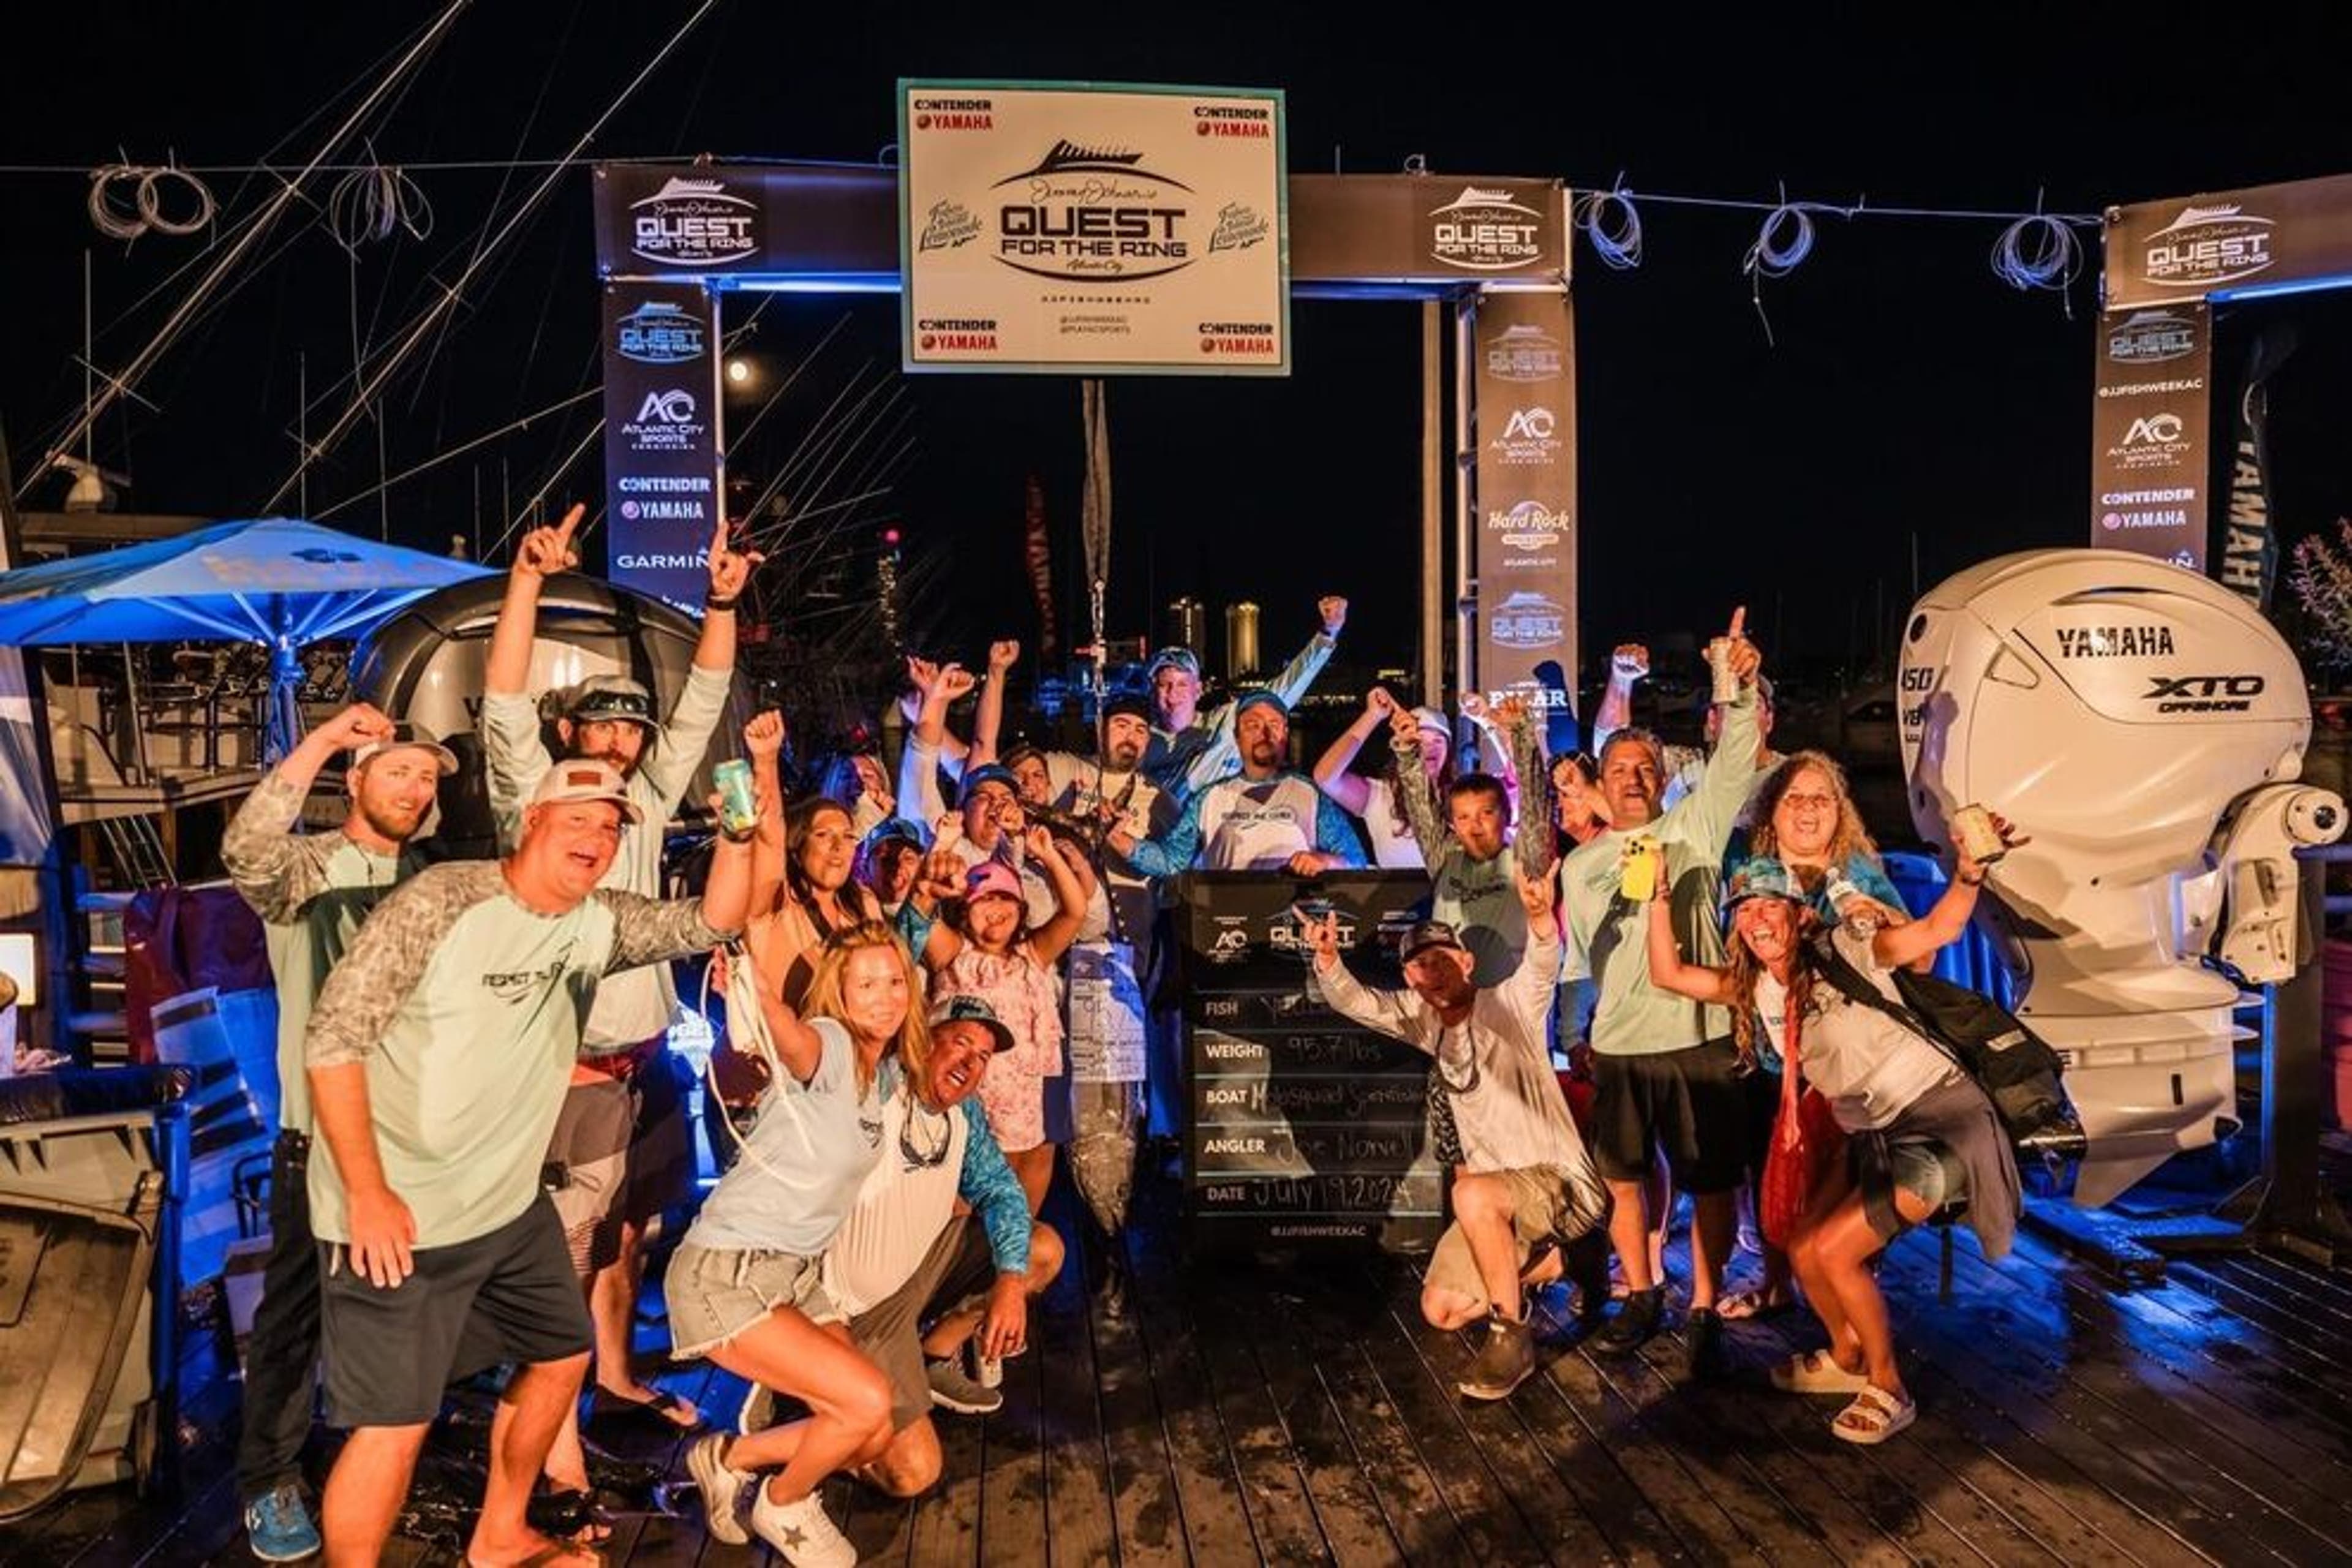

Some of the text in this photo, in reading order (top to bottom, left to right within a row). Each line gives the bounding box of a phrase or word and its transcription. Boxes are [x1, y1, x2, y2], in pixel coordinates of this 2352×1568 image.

[914, 99, 991, 110] CONTENDER
[1194, 106, 1268, 119] CONTENDER
[933, 114, 992, 129] YAMAHA
[1213, 123, 1269, 138] YAMAHA
[636, 217, 752, 238] QUEST
[1001, 206, 1186, 239] QUEST
[636, 237, 753, 248] FOR THE RING
[1434, 225, 1538, 244] QUEST
[1002, 239, 1187, 257] FOR THE RING
[1434, 244, 1538, 254] FOR THE RING
[2147, 233, 2269, 266] QUEST
[2147, 264, 2182, 276] FOR
[2185, 260, 2219, 271] THE
[2222, 252, 2269, 266] RING
[919, 320, 997, 330] CONTENDER
[1199, 322, 1273, 335] CONTENDER
[620, 328, 703, 344] QUEST
[938, 335, 997, 350] YAMAHA
[2109, 330, 2194, 350] QUEST
[1216, 338, 1274, 353] YAMAHA
[636, 388, 695, 423] AC
[1504, 407, 1555, 438] AC
[2122, 413, 2182, 445] AC
[619, 477, 710, 492] CONTENDER
[2101, 488, 2196, 505] CONTENDER
[641, 500, 704, 519] YAMAHA
[1488, 510, 1569, 531] Hard Rock
[2121, 510, 2186, 528] YAMAHA
[2057, 627, 2174, 658] YAMAHA
[2141, 676, 2265, 699] XTO
[1488, 689, 1567, 709] PAR
[2157, 699, 2250, 713] OFFSHORE
[1270, 926, 1355, 942] QUT
[1206, 1002, 1238, 1016] FISH
[1206, 1044, 1264, 1058] WEIGHT
[1206, 1090, 1248, 1103] BOAT
[1204, 1139, 1267, 1153] ANGLER
[1207, 1186, 1246, 1200] DATE
[1253, 1178, 1313, 1210] July
